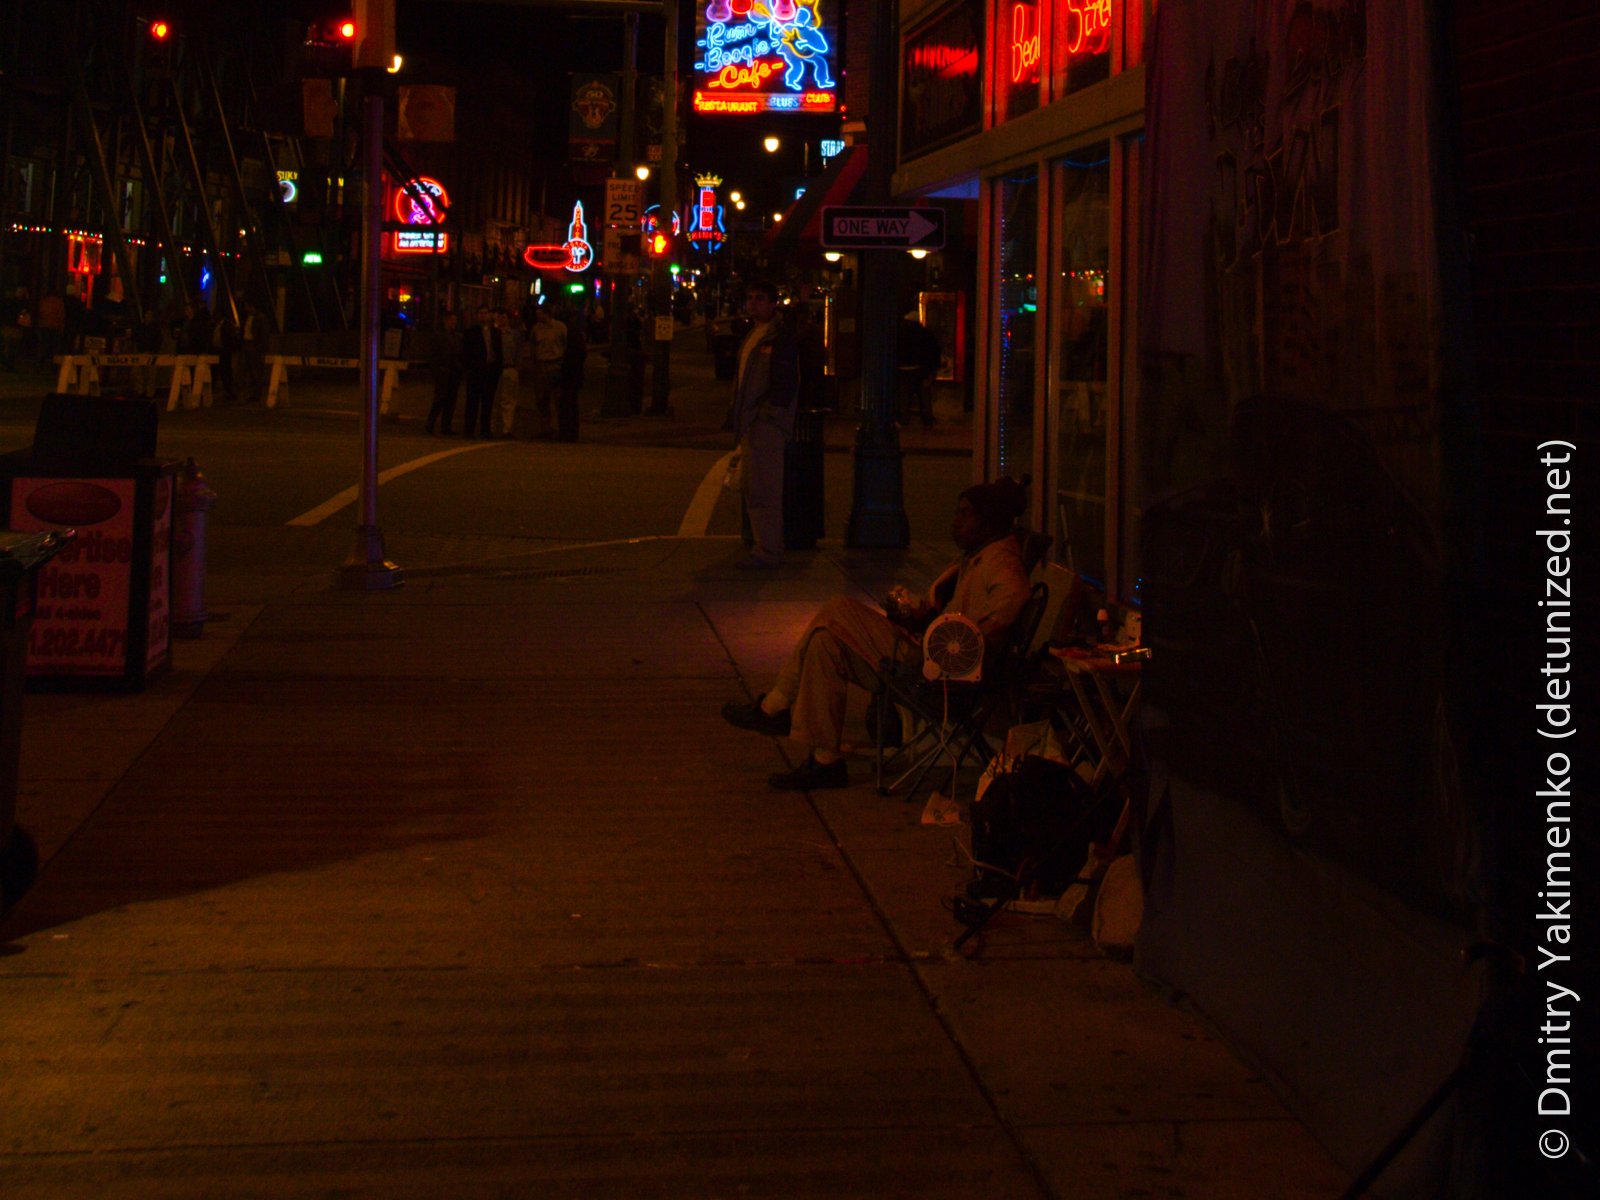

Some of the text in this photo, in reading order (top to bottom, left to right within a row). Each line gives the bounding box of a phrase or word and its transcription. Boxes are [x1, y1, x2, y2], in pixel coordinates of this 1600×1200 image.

[704, 38, 770, 73] Boogie
[719, 59, 772, 89] Cafe
[698, 93, 831, 113] RESTAURANT BLUES CLUB
[610, 203, 638, 221] 25
[837, 219, 910, 234] ONE WAY
